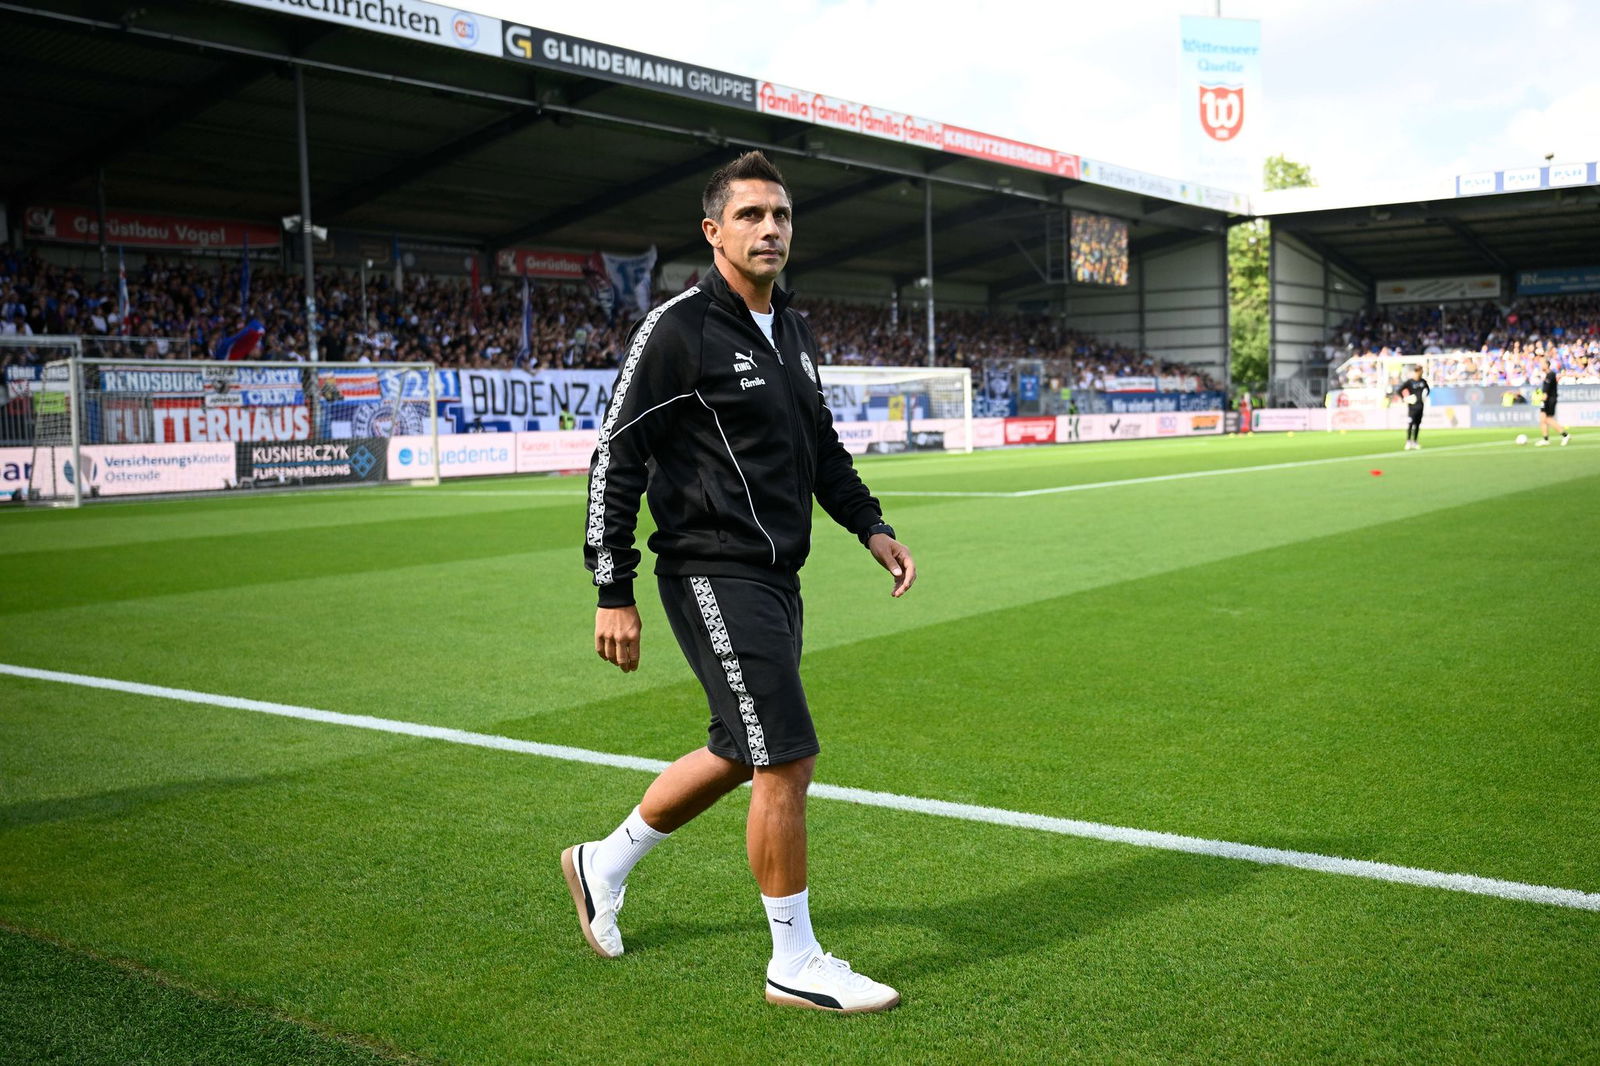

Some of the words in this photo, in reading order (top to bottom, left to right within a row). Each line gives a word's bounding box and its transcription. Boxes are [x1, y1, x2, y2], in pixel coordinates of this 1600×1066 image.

[543, 37, 685, 88] GLINDEMANN
[686, 71, 752, 101] GRUPPE
[760, 82, 808, 120] famila
[811, 93, 856, 124] famila
[859, 104, 900, 133] famila
[903, 115, 942, 143] famila
[944, 127, 1055, 168] KREUTZBERGER
[175, 225, 226, 246] Vogel
[733, 361, 752, 373] KING
[104, 371, 204, 392] RENDSBURG
[740, 377, 766, 391] famila
[247, 390, 297, 405] CREW
[252, 445, 349, 463] KUSNIERCZYK
[418, 445, 508, 465] bluedenta
[104, 470, 161, 483] Osterode
